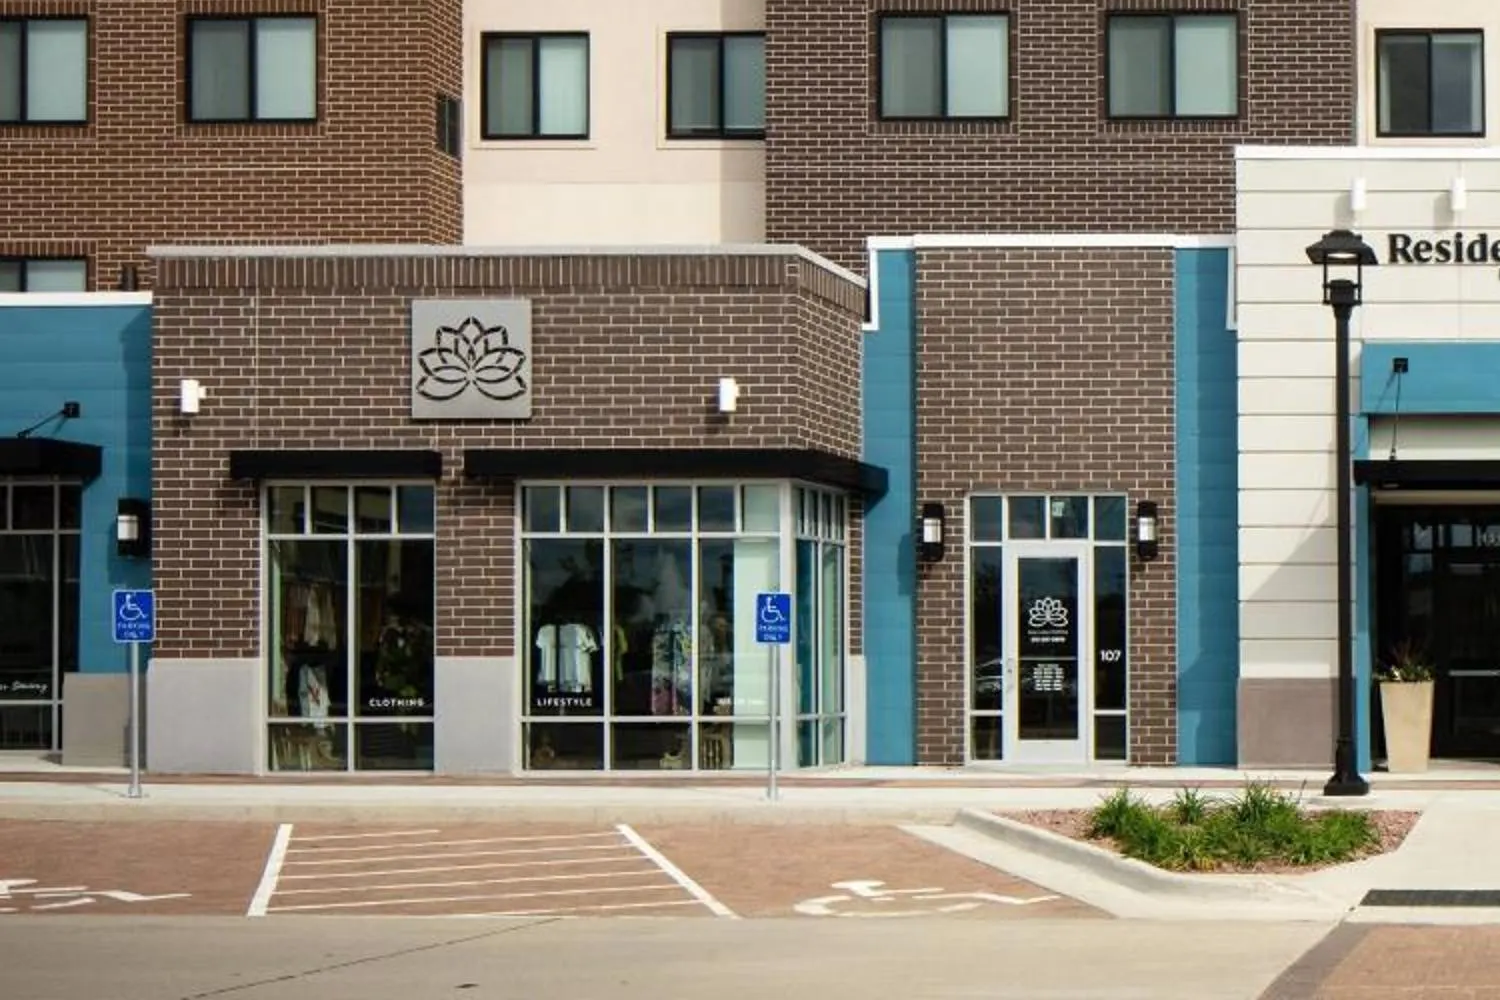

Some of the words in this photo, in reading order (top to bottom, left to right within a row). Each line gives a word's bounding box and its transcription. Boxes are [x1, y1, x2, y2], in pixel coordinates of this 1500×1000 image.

[1100, 649, 1121, 661] 107
[368, 697, 424, 708] CLOTHING
[536, 697, 593, 708] LIFESTYLE
